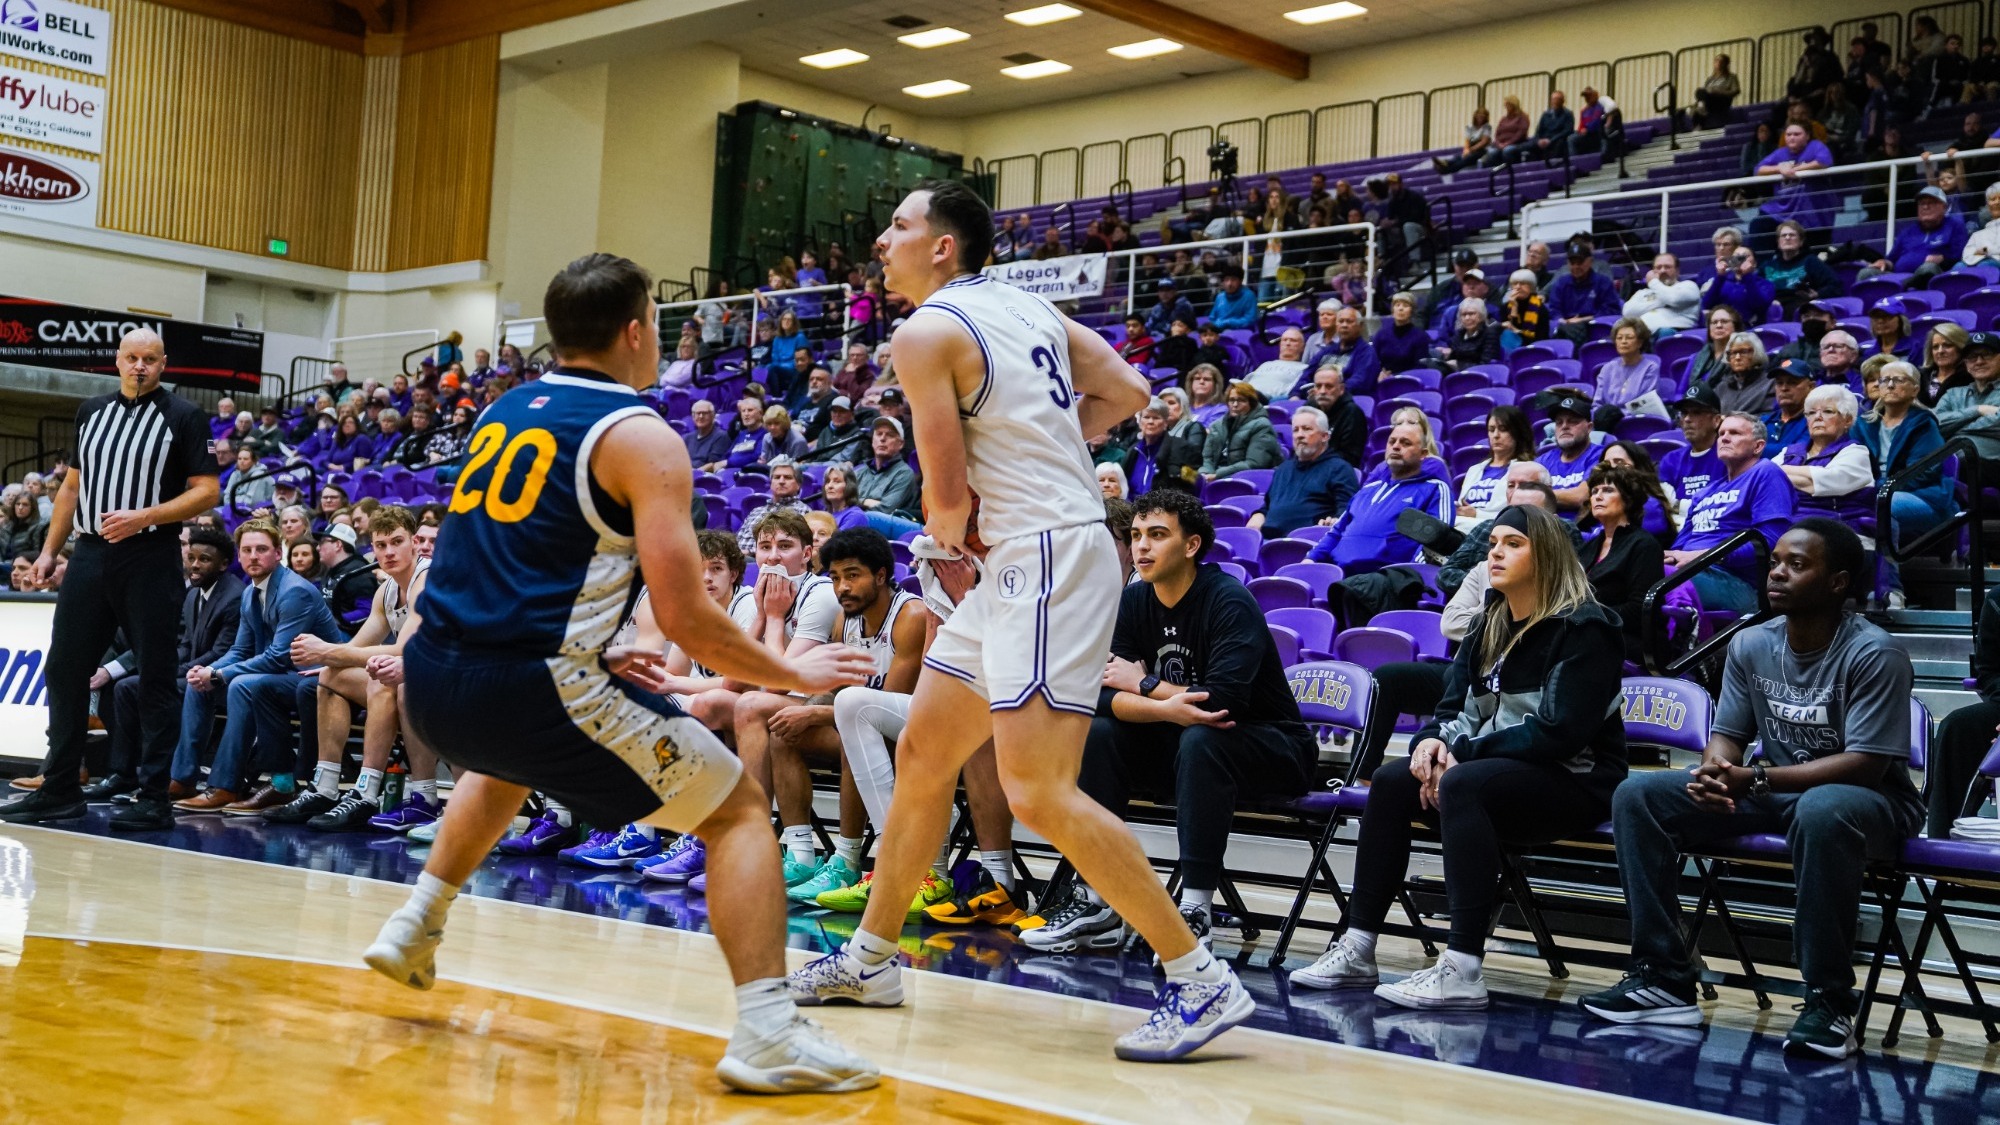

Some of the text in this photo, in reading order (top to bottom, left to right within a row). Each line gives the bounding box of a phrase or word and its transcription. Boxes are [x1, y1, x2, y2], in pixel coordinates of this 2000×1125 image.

[45, 12, 95, 39] BELL
[0, 31, 92, 65] lWorks.com
[40, 84, 95, 118] lube
[49, 122, 91, 138] Caldwell
[1007, 267, 1061, 281] Legacy
[1018, 281, 1064, 293] ogram
[42, 347, 90, 356] PUBLISHING
[1031, 345, 1074, 410] 3
[448, 422, 558, 523] 20
[1295, 669, 1336, 680] COLLEGE
[1289, 677, 1352, 711] DAHO
[1668, 691, 1678, 699] OF
[1753, 674, 1846, 704] TOUGHEST
[1772, 703, 1818, 722] TEAM
[1765, 717, 1840, 749] WINS
